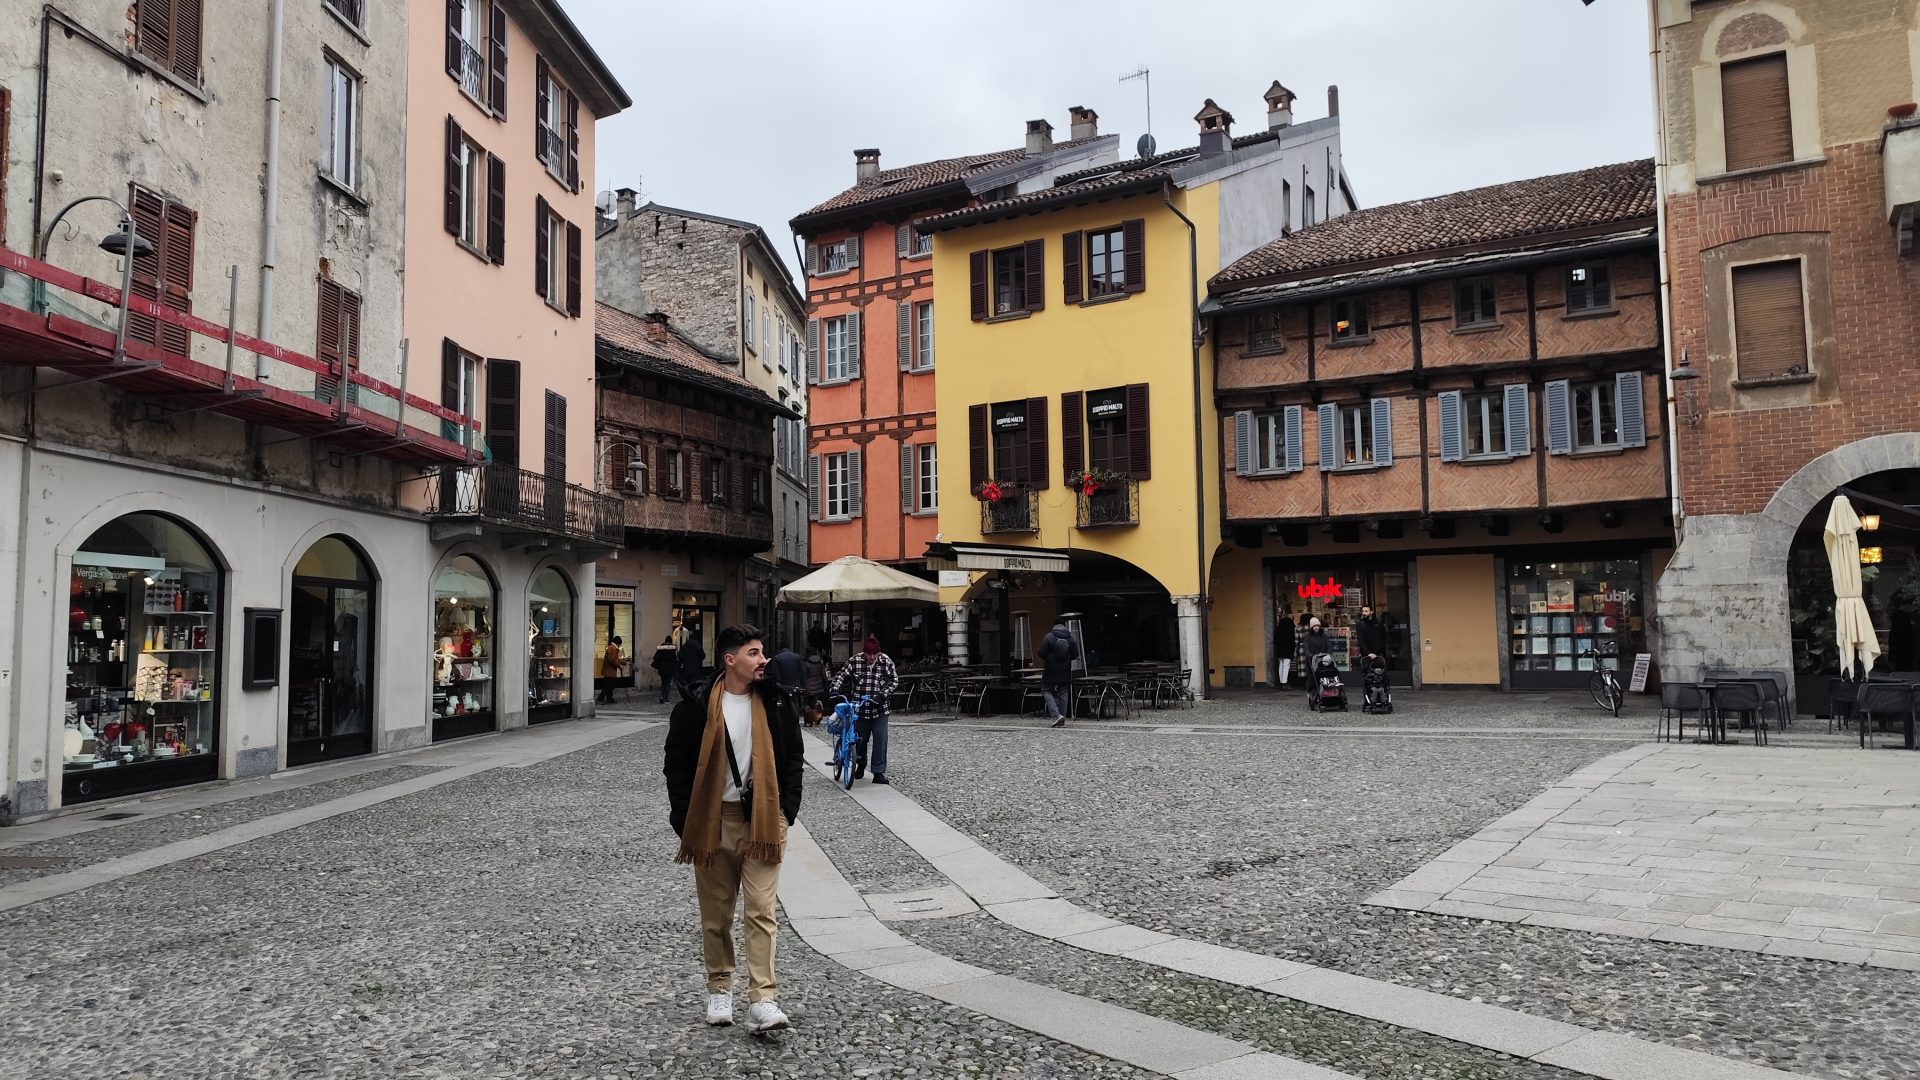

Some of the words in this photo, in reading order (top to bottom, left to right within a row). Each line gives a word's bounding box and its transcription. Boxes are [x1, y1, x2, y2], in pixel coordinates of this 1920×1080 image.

[595, 588, 632, 598] bellissima
[1298, 577, 1343, 604] ubik
[1604, 588, 1637, 602] ubik
